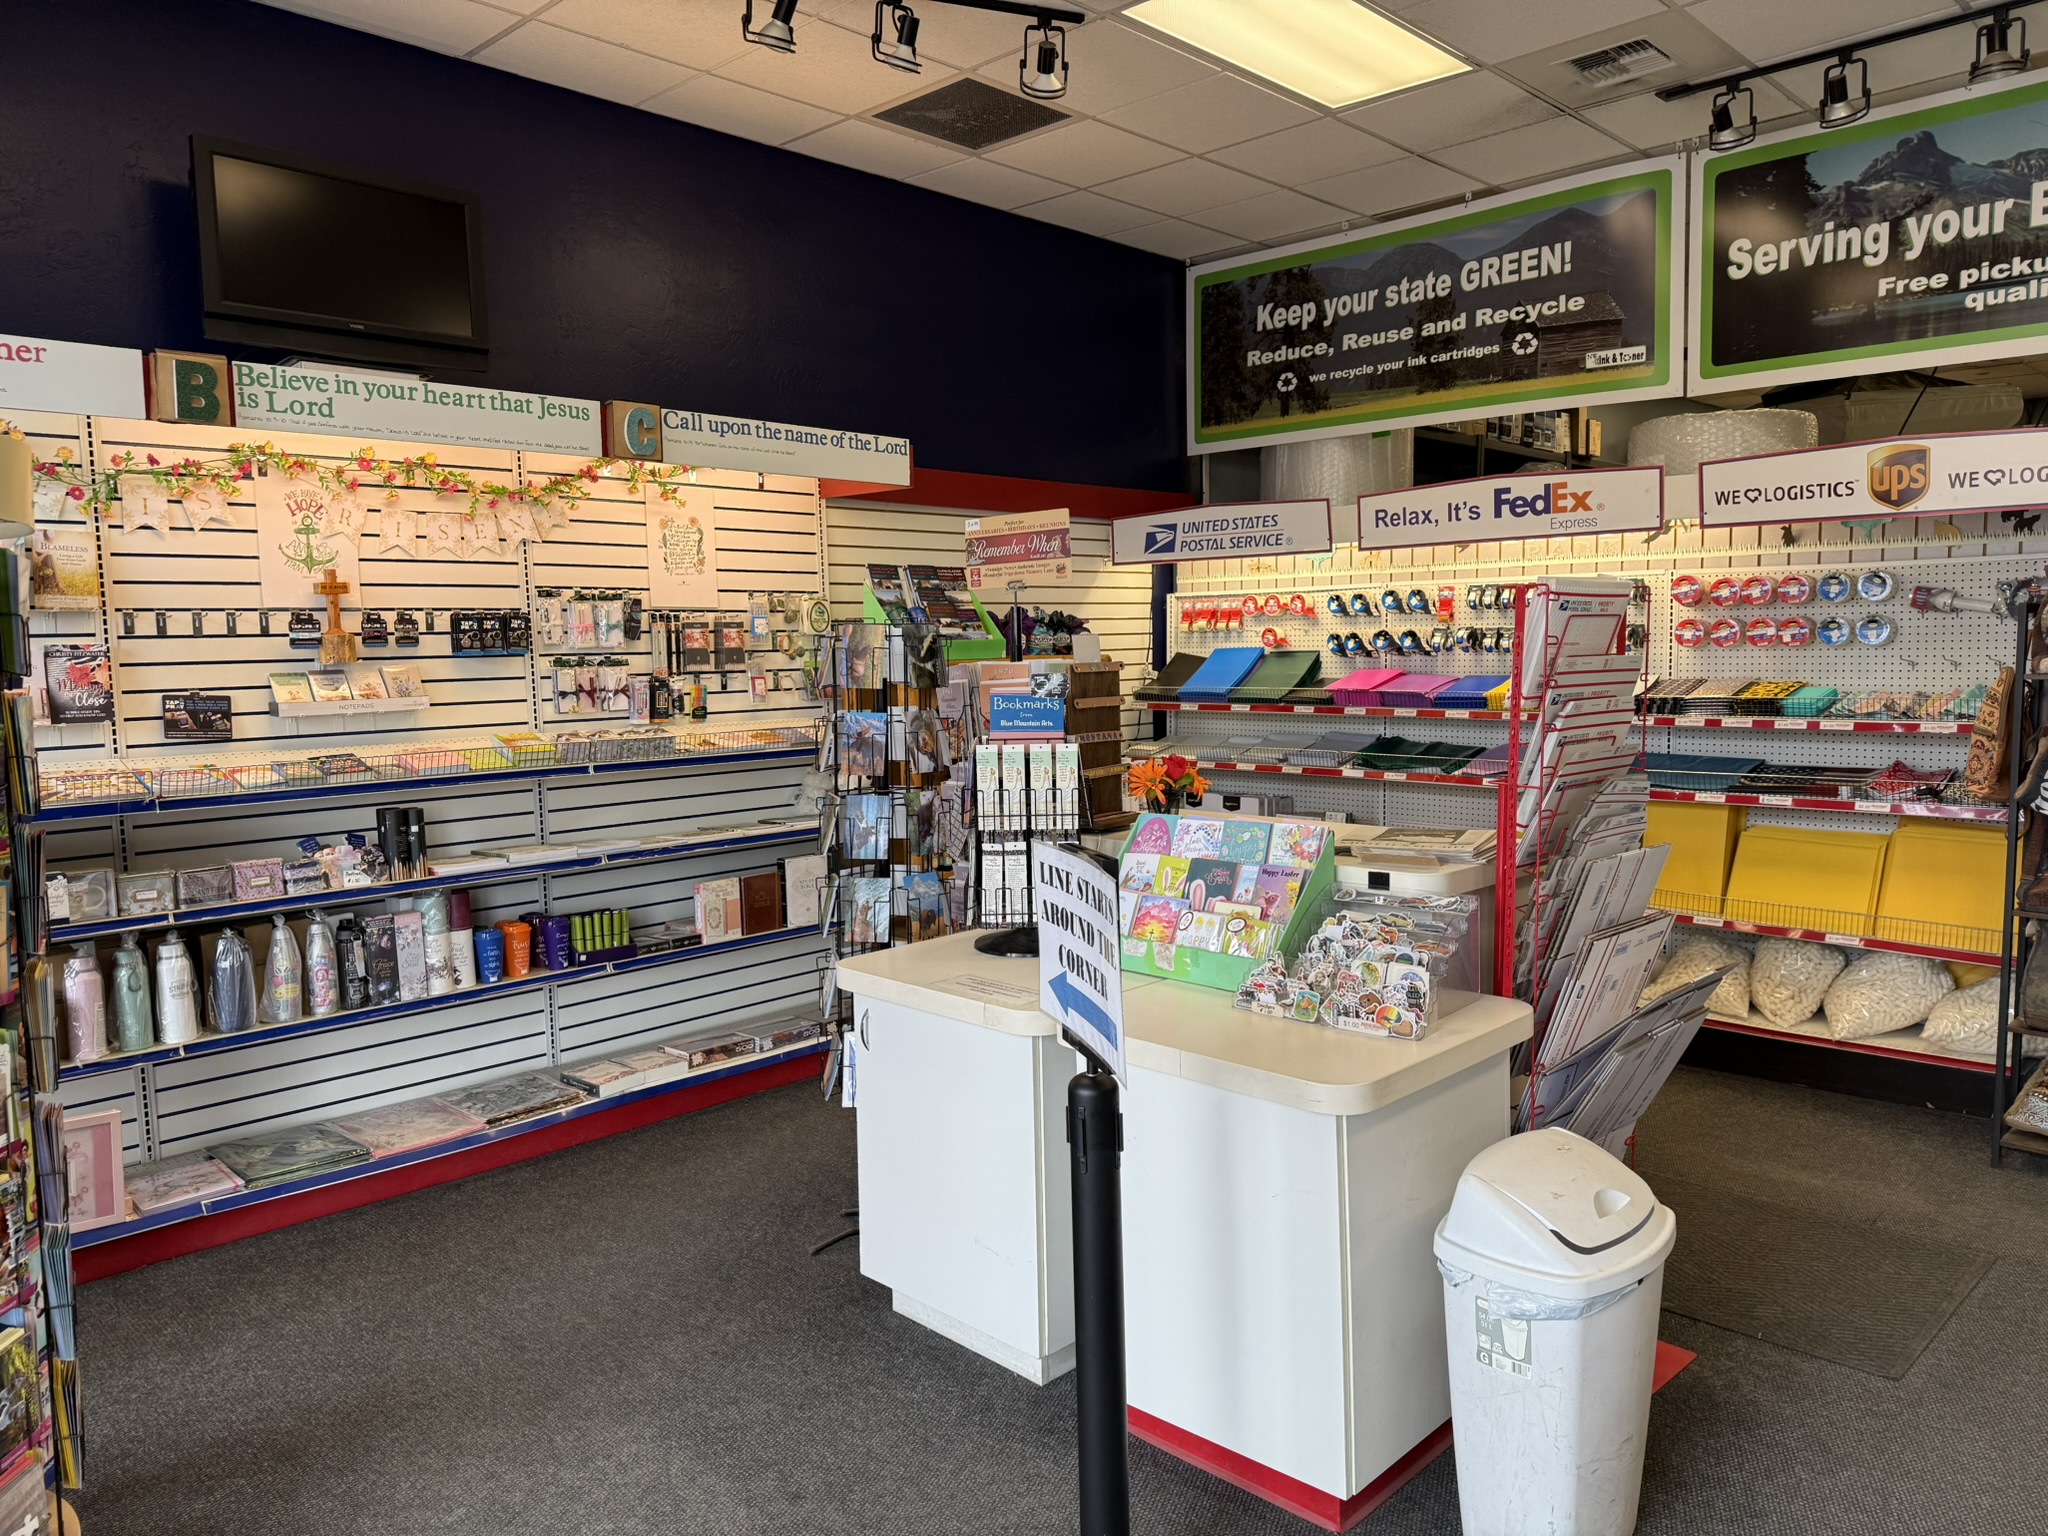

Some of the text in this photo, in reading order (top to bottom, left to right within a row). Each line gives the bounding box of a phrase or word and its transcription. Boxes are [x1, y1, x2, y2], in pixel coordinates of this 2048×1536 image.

[1727, 197, 2016, 280] Serving your
[1256, 240, 1573, 333] Keep your state GREEN!
[1878, 271, 1950, 298] Free
[1247, 294, 1586, 367] Reduce, Reuse and Recycle
[1308, 343, 1501, 383] we recycle your ink cartridges
[1599, 353, 1611, 365] Ink
[1612, 351, 1618, 363] &
[172, 359, 221, 422] B
[234, 363, 592, 421] Believe in your heart that Jesus
[237, 387, 336, 419] is Lord
[624, 406, 657, 456] C
[663, 410, 704, 432] Call
[707, 419, 753, 438] upon
[755, 421, 782, 440] the
[784, 429, 828, 447] name
[830, 431, 847, 449] of
[848, 433, 873, 452] the
[873, 436, 909, 457] Lord
[1715, 480, 1856, 506] WE LOGISTICS
[1872, 463, 1927, 502] ups
[1948, 471, 1981, 490] WE
[285, 498, 329, 521] HOPE
[1374, 506, 1440, 529] Relax,
[1493, 481, 1594, 519] FedEx
[1182, 514, 1279, 535] UNITED STATES
[1550, 516, 1599, 532] Express
[41, 541, 89, 554] BLAMELESS
[972, 533, 1059, 560] Remember When
[1180, 533, 1284, 553] POSTAL SERVICE
[75, 692, 107, 707] Close
[338, 703, 375, 711] NOTEPADS
[993, 696, 1061, 711] Bookmarks
[1000, 719, 1013, 727] Blue
[1014, 719, 1041, 727] Mountain
[1080, 732, 1119, 742] MONTANA
[1262, 868, 1300, 879] Happy Easter
[1039, 861, 1115, 926] LINE STARTS
[1041, 898, 1096, 949] AROUND
[1097, 927, 1117, 971] THE
[1181, 934, 1210, 945] HAPPY
[1058, 943, 1109, 1001] CORNER
[1343, 1020, 1360, 1029] $1.00
[1480, 1352, 1489, 1364] G
